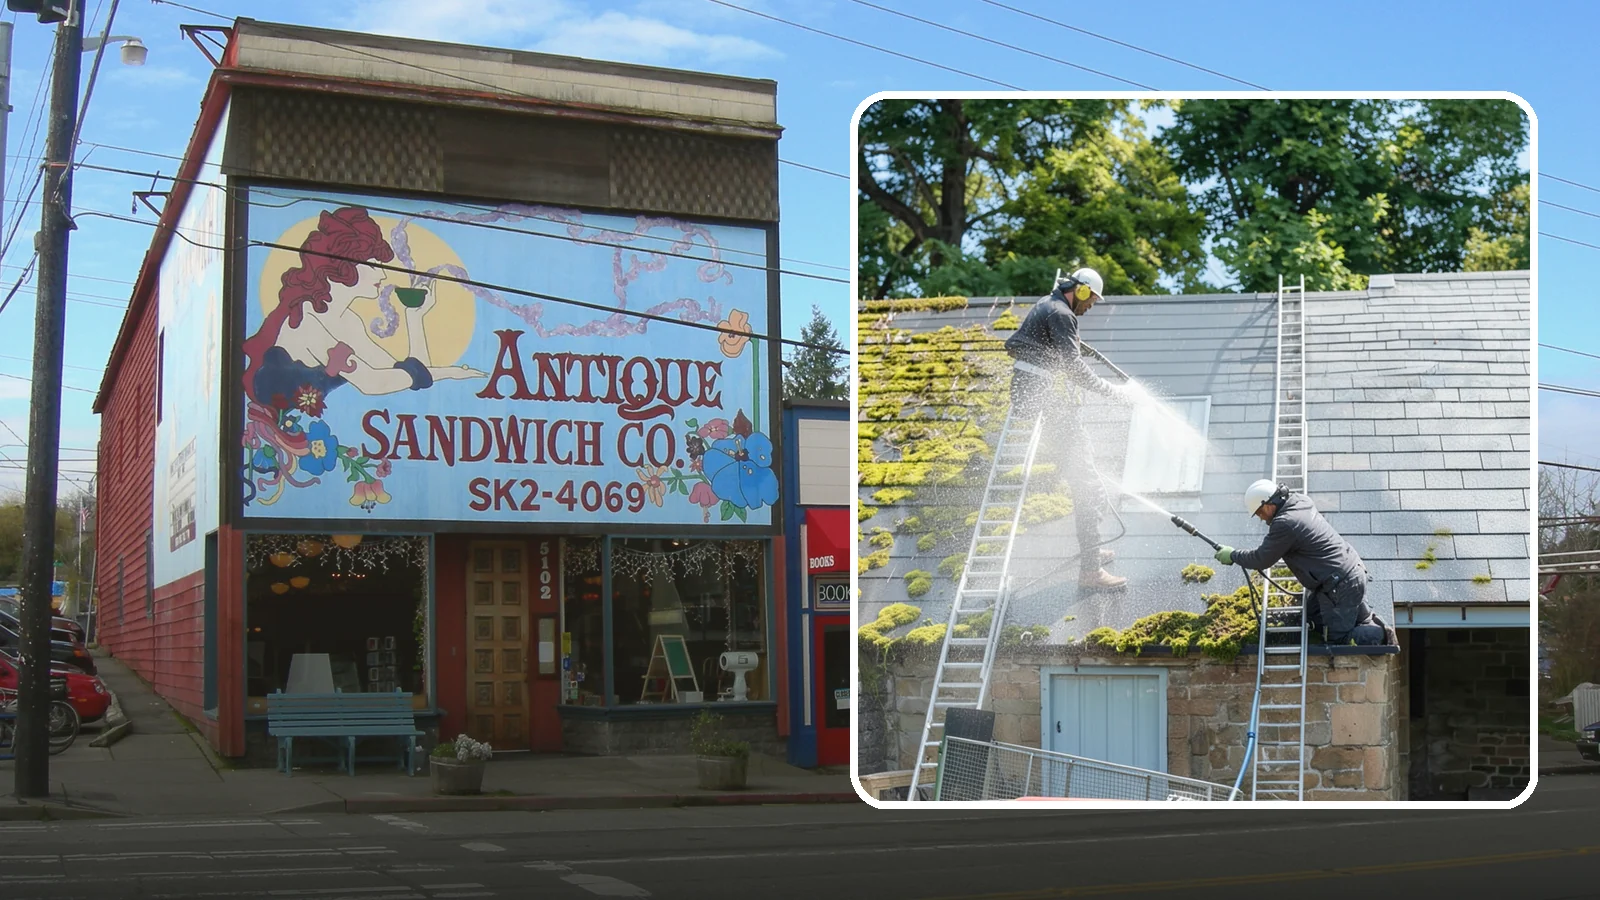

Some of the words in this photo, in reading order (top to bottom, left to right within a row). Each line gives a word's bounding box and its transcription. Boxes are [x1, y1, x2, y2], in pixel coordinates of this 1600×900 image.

[477, 329, 722, 420] ANTIQUE
[362, 409, 604, 467] SANDWICH
[617, 421, 684, 468] CO.
[468, 478, 645, 511] SK2-4069
[540, 541, 551, 600] 5102
[809, 555, 835, 569] BOOKS
